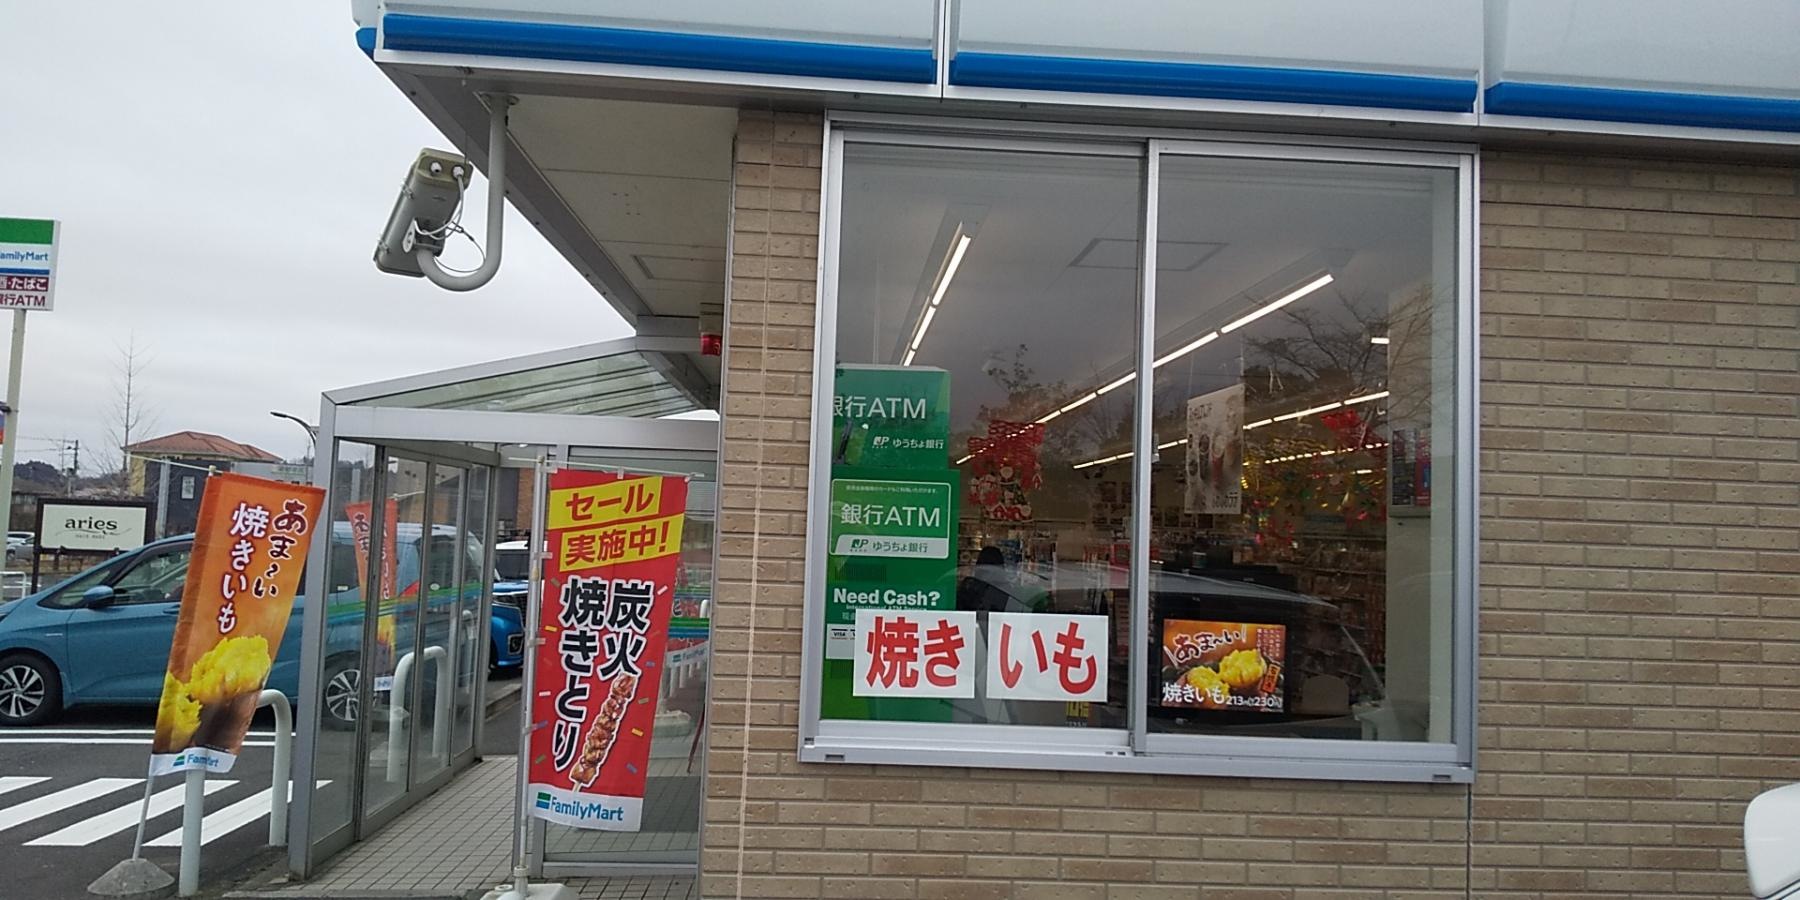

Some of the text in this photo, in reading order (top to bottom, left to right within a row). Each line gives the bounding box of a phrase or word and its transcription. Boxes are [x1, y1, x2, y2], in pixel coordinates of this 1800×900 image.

[0, 251, 48, 261] amilyMart
[893, 439, 944, 449] ゆうちょ銀行
[565, 484, 654, 521] セール
[65, 516, 118, 530] aries
[841, 504, 940, 527] 銀行ATM
[565, 521, 669, 566] 実施中!
[872, 541, 928, 553] ゆうちょ銀行
[218, 502, 269, 633] 焼きいも
[833, 588, 941, 606] Need Cash?
[600, 581, 653, 676] 炭火
[866, 616, 1097, 695] 焼き いも
[554, 578, 605, 767] 焼きとり
[1163, 683, 1225, 704] 焼きいも
[551, 796, 624, 821] FamilyMart
